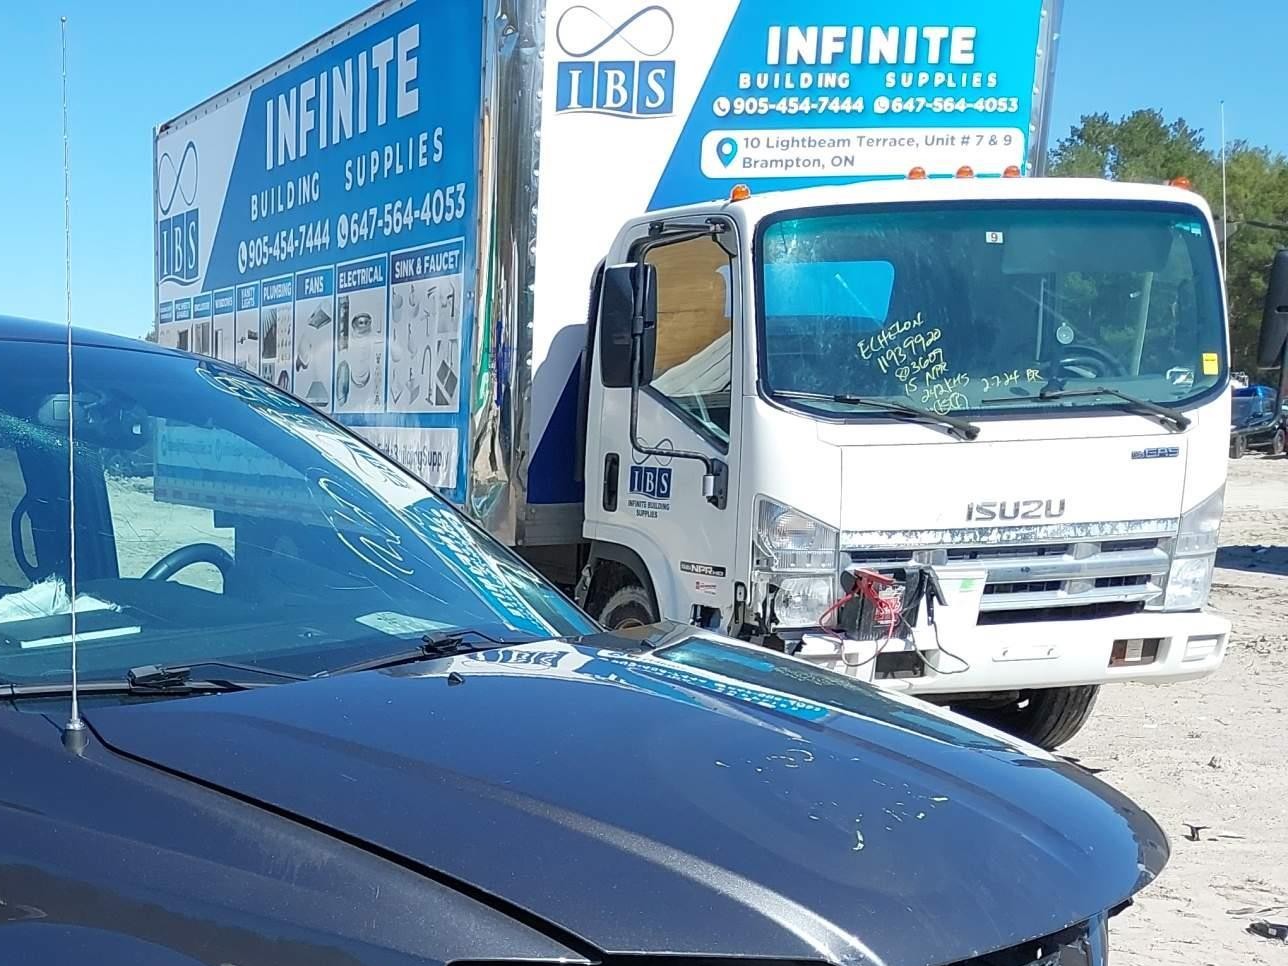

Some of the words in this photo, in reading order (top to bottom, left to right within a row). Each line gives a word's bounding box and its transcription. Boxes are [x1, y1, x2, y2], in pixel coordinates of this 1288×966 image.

[766, 25, 977, 65] INFINITE
[567, 66, 668, 109] IBS
[739, 72, 850, 89] BUILDING
[885, 71, 998, 88] SUPPLIES
[265, 24, 421, 171] INFINITE
[732, 96, 864, 114] 905-454-7444
[891, 96, 1019, 113] 647-564-4053
[743, 137, 761, 149] 10
[766, 135, 851, 151] Lightbeam
[856, 135, 920, 149] Terrace,
[924, 134, 956, 147] Unit
[961, 135, 971, 146] #
[975, 135, 984, 146] 7
[988, 134, 999, 146] &
[1003, 134, 1013, 146] 9
[742, 156, 825, 170] Brampton,
[831, 155, 856, 168] ON
[251, 172, 320, 222] BUILDING
[345, 127, 444, 191] SUPPLIES
[247, 219, 330, 268] 905-454-7444
[349, 183, 466, 242] 647-564-4053
[162, 222, 197, 276] IBS
[394, 262, 415, 279] SINK
[423, 250, 460, 274] FAUCET
[304, 276, 324, 295] FANS
[338, 265, 384, 289] ELECTRICAL
[263, 282, 292, 300] PLUMBING
[632, 470, 669, 494] IBS
[628, 500, 647, 508] INFINITE
[647, 501, 670, 511] BUILDING
[636, 509, 658, 518] SUPPLIES
[966, 498, 1066, 521] ISUZU
